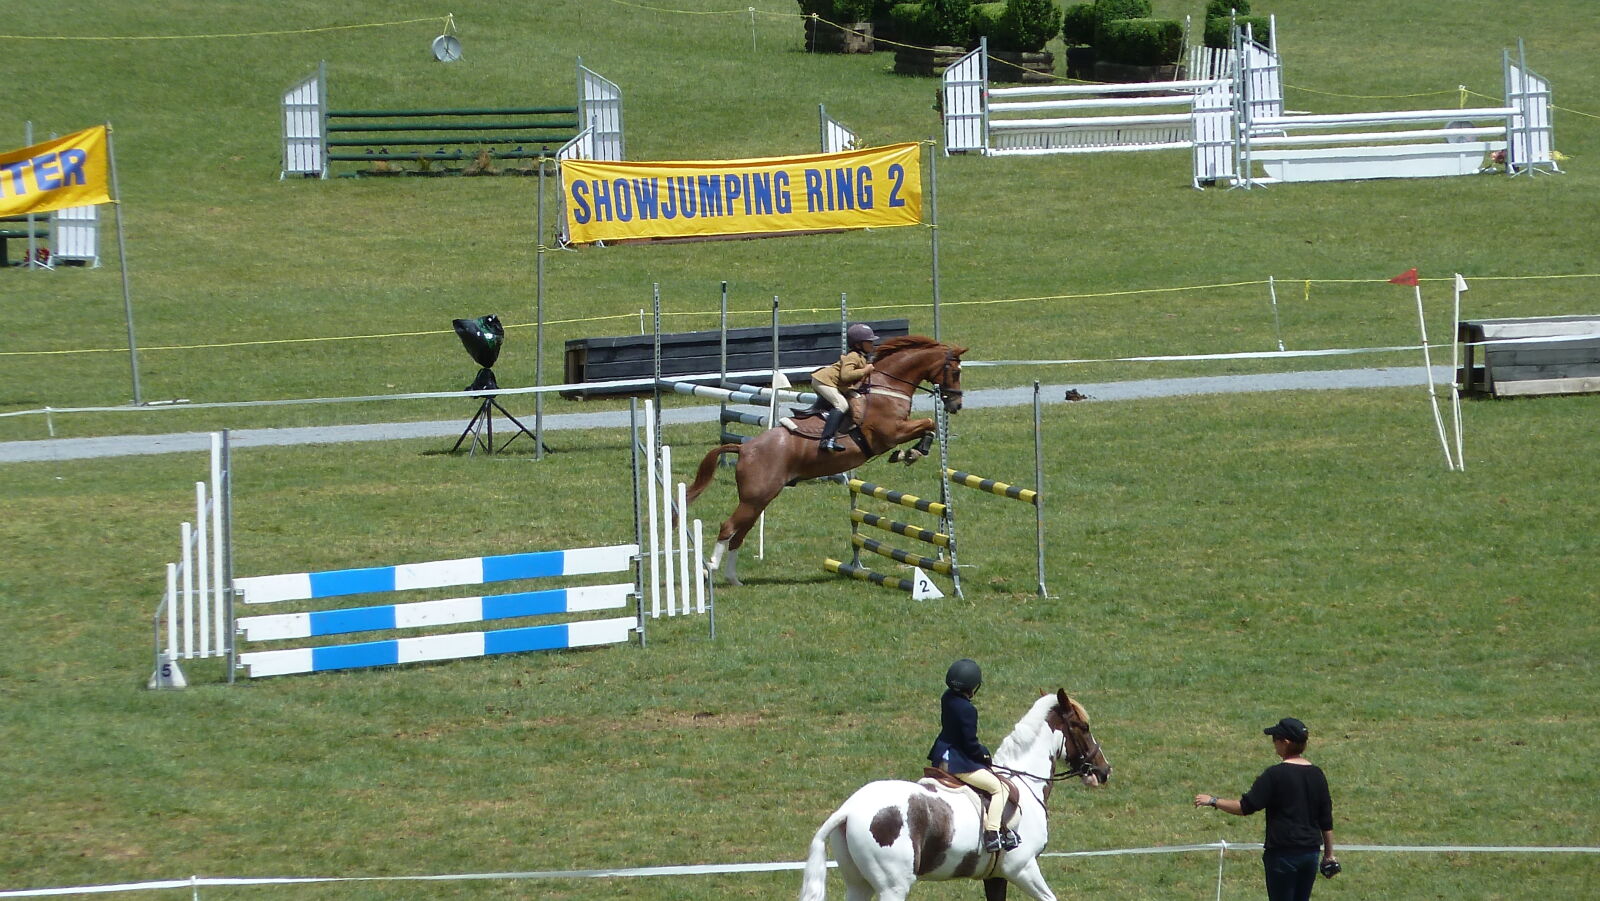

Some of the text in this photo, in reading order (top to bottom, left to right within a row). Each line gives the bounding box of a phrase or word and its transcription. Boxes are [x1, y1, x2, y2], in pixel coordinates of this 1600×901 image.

[0, 149, 87, 198] TER
[571, 163, 906, 225] SHOWJUMPING RING 2
[920, 580, 930, 592] 2
[162, 664, 171, 677] 5
